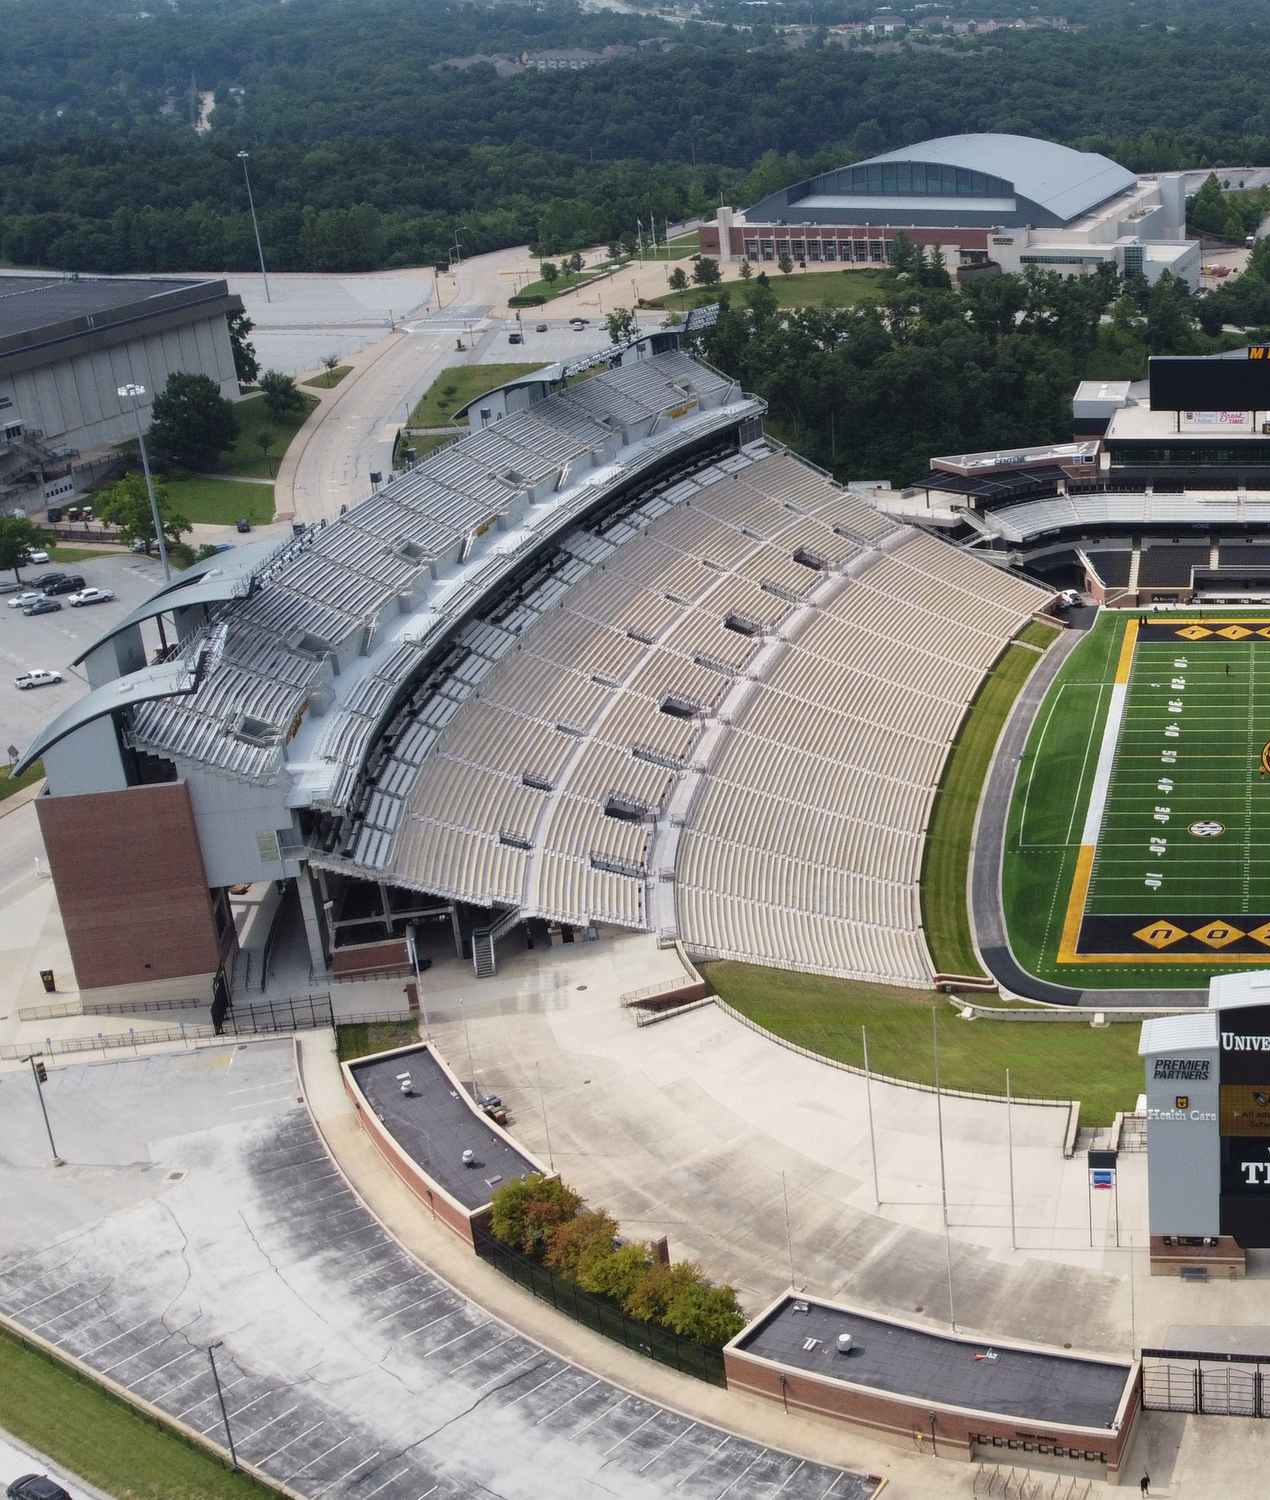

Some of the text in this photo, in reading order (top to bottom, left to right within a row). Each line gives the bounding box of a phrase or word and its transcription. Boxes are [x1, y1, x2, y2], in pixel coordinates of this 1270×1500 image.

[1149, 837, 1167, 853] 20
[1145, 873, 1163, 887] 10
[1154, 1059, 1210, 1071] PREMIER
[1153, 1070, 1210, 1080] PARTNERS
[1147, 1108, 1217, 1121] Health Care
